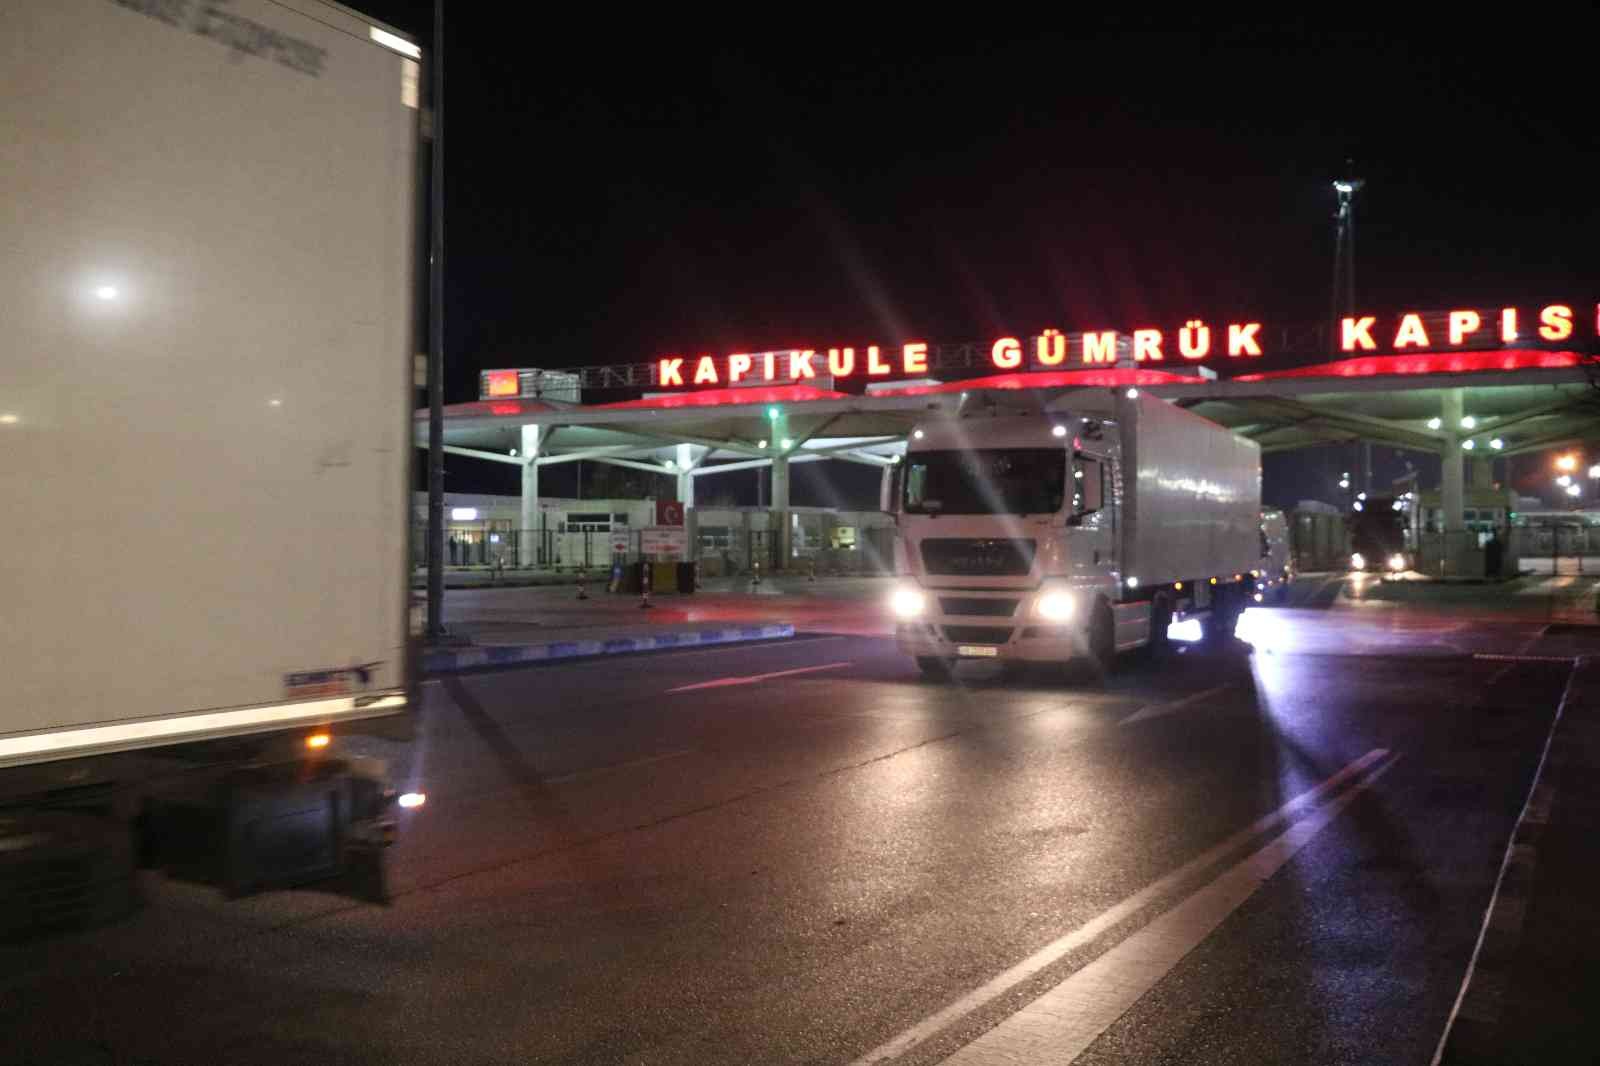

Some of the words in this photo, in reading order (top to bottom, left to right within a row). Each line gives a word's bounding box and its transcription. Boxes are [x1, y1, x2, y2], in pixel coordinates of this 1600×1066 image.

[659, 343, 928, 386] KAPIKULE
[991, 320, 1262, 369] GÜMRÜK
[1341, 303, 1600, 351] KAPIS
